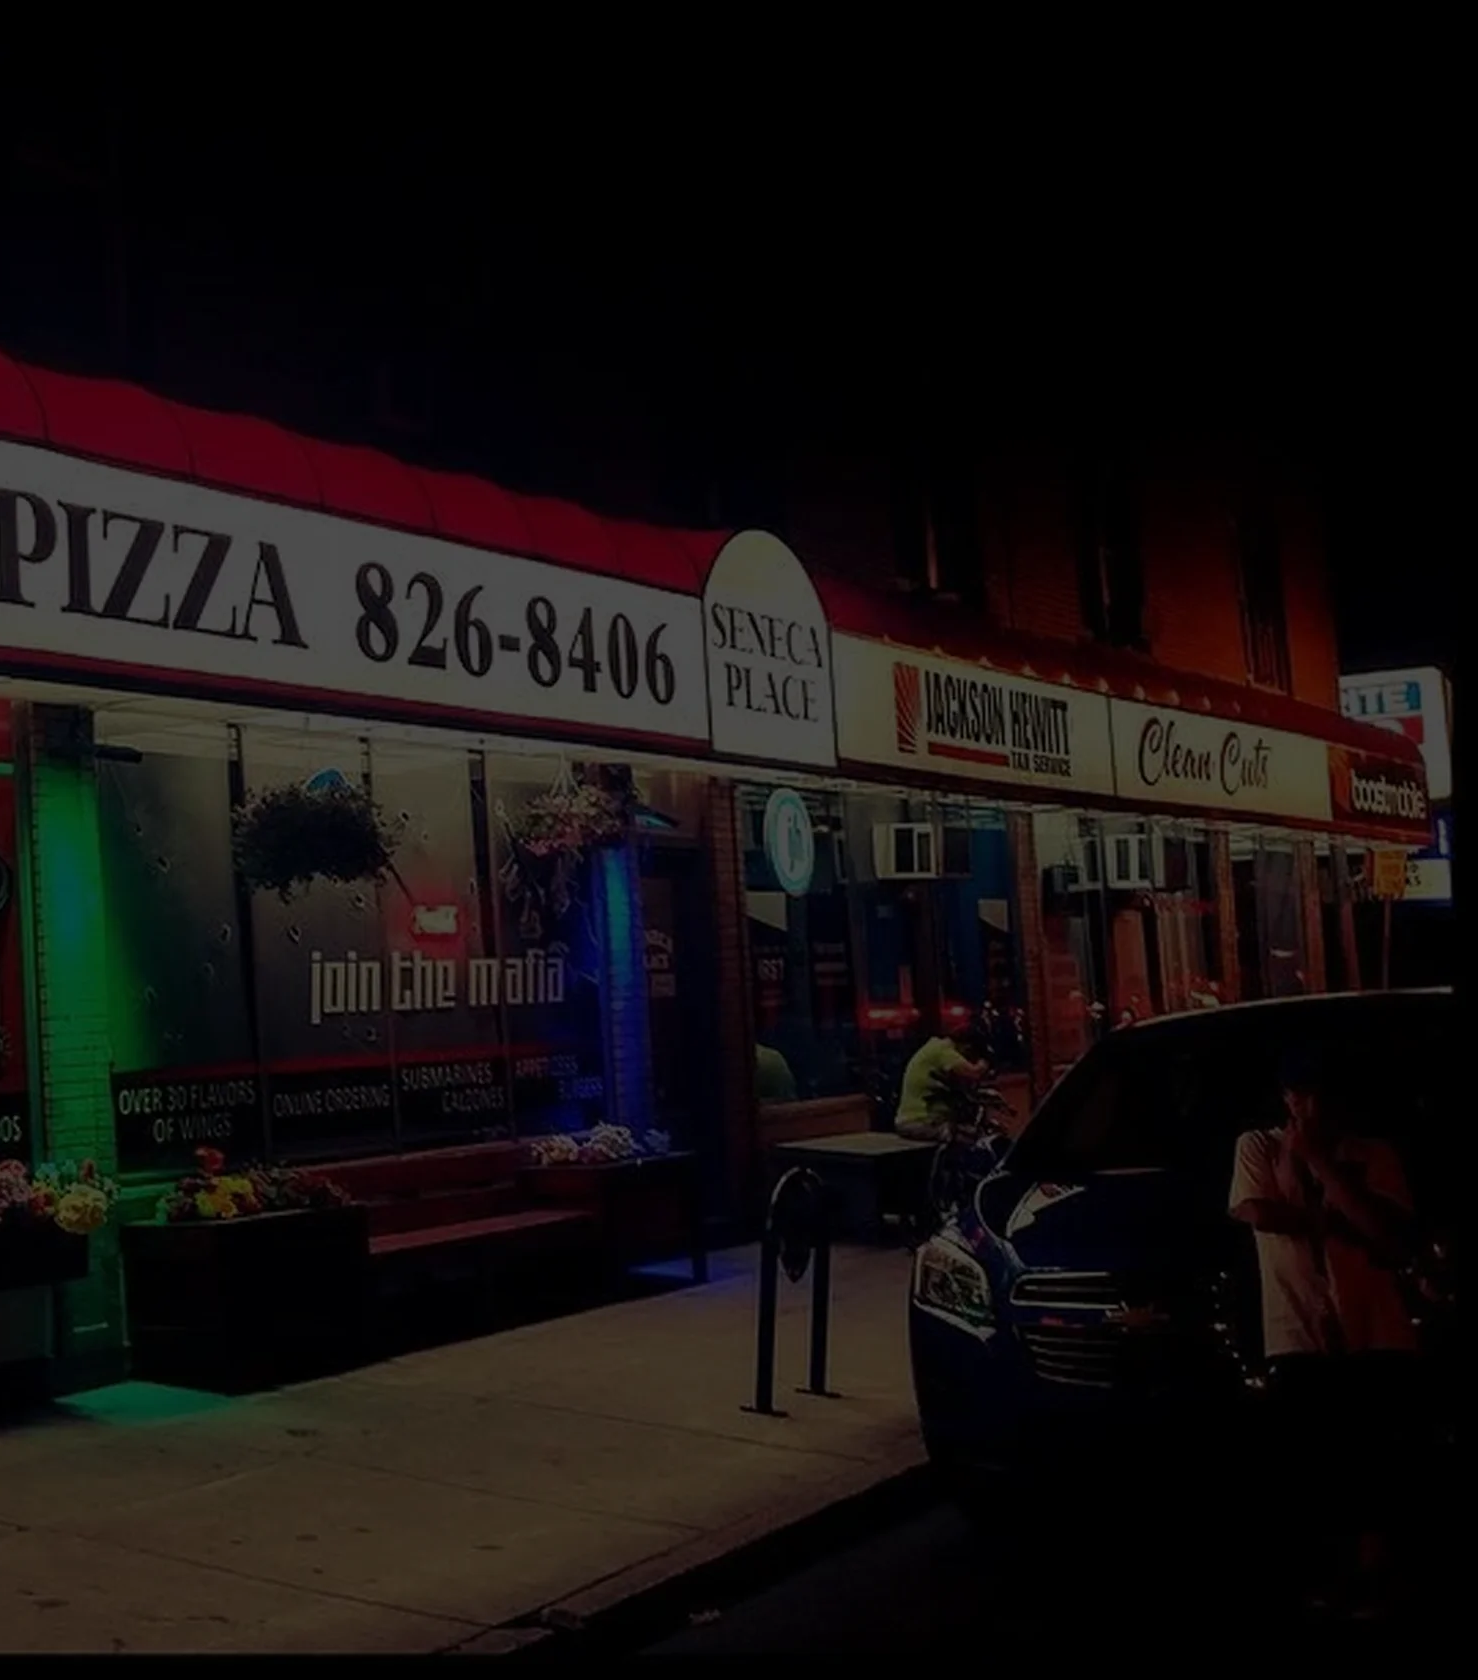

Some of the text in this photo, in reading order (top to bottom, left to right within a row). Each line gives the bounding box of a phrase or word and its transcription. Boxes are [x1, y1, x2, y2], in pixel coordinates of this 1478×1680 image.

[355, 561, 677, 705] 826-8406
[710, 602, 823, 668] SENECA
[724, 661, 820, 722] PLACE
[925, 669, 1071, 757] JACKSON HEWITT
[1010, 751, 1073, 778] TAX SERVICE
[1138, 716, 1274, 796] Clean Cuts
[311, 947, 565, 1026] join the mafia
[118, 1079, 257, 1116] OVER 30 FLAVORS
[324, 1083, 391, 1113] ORDERING
[401, 1061, 495, 1092] SUBMARINES
[441, 1086, 508, 1115] CALZONES
[152, 1112, 233, 1143] OF WINGS
